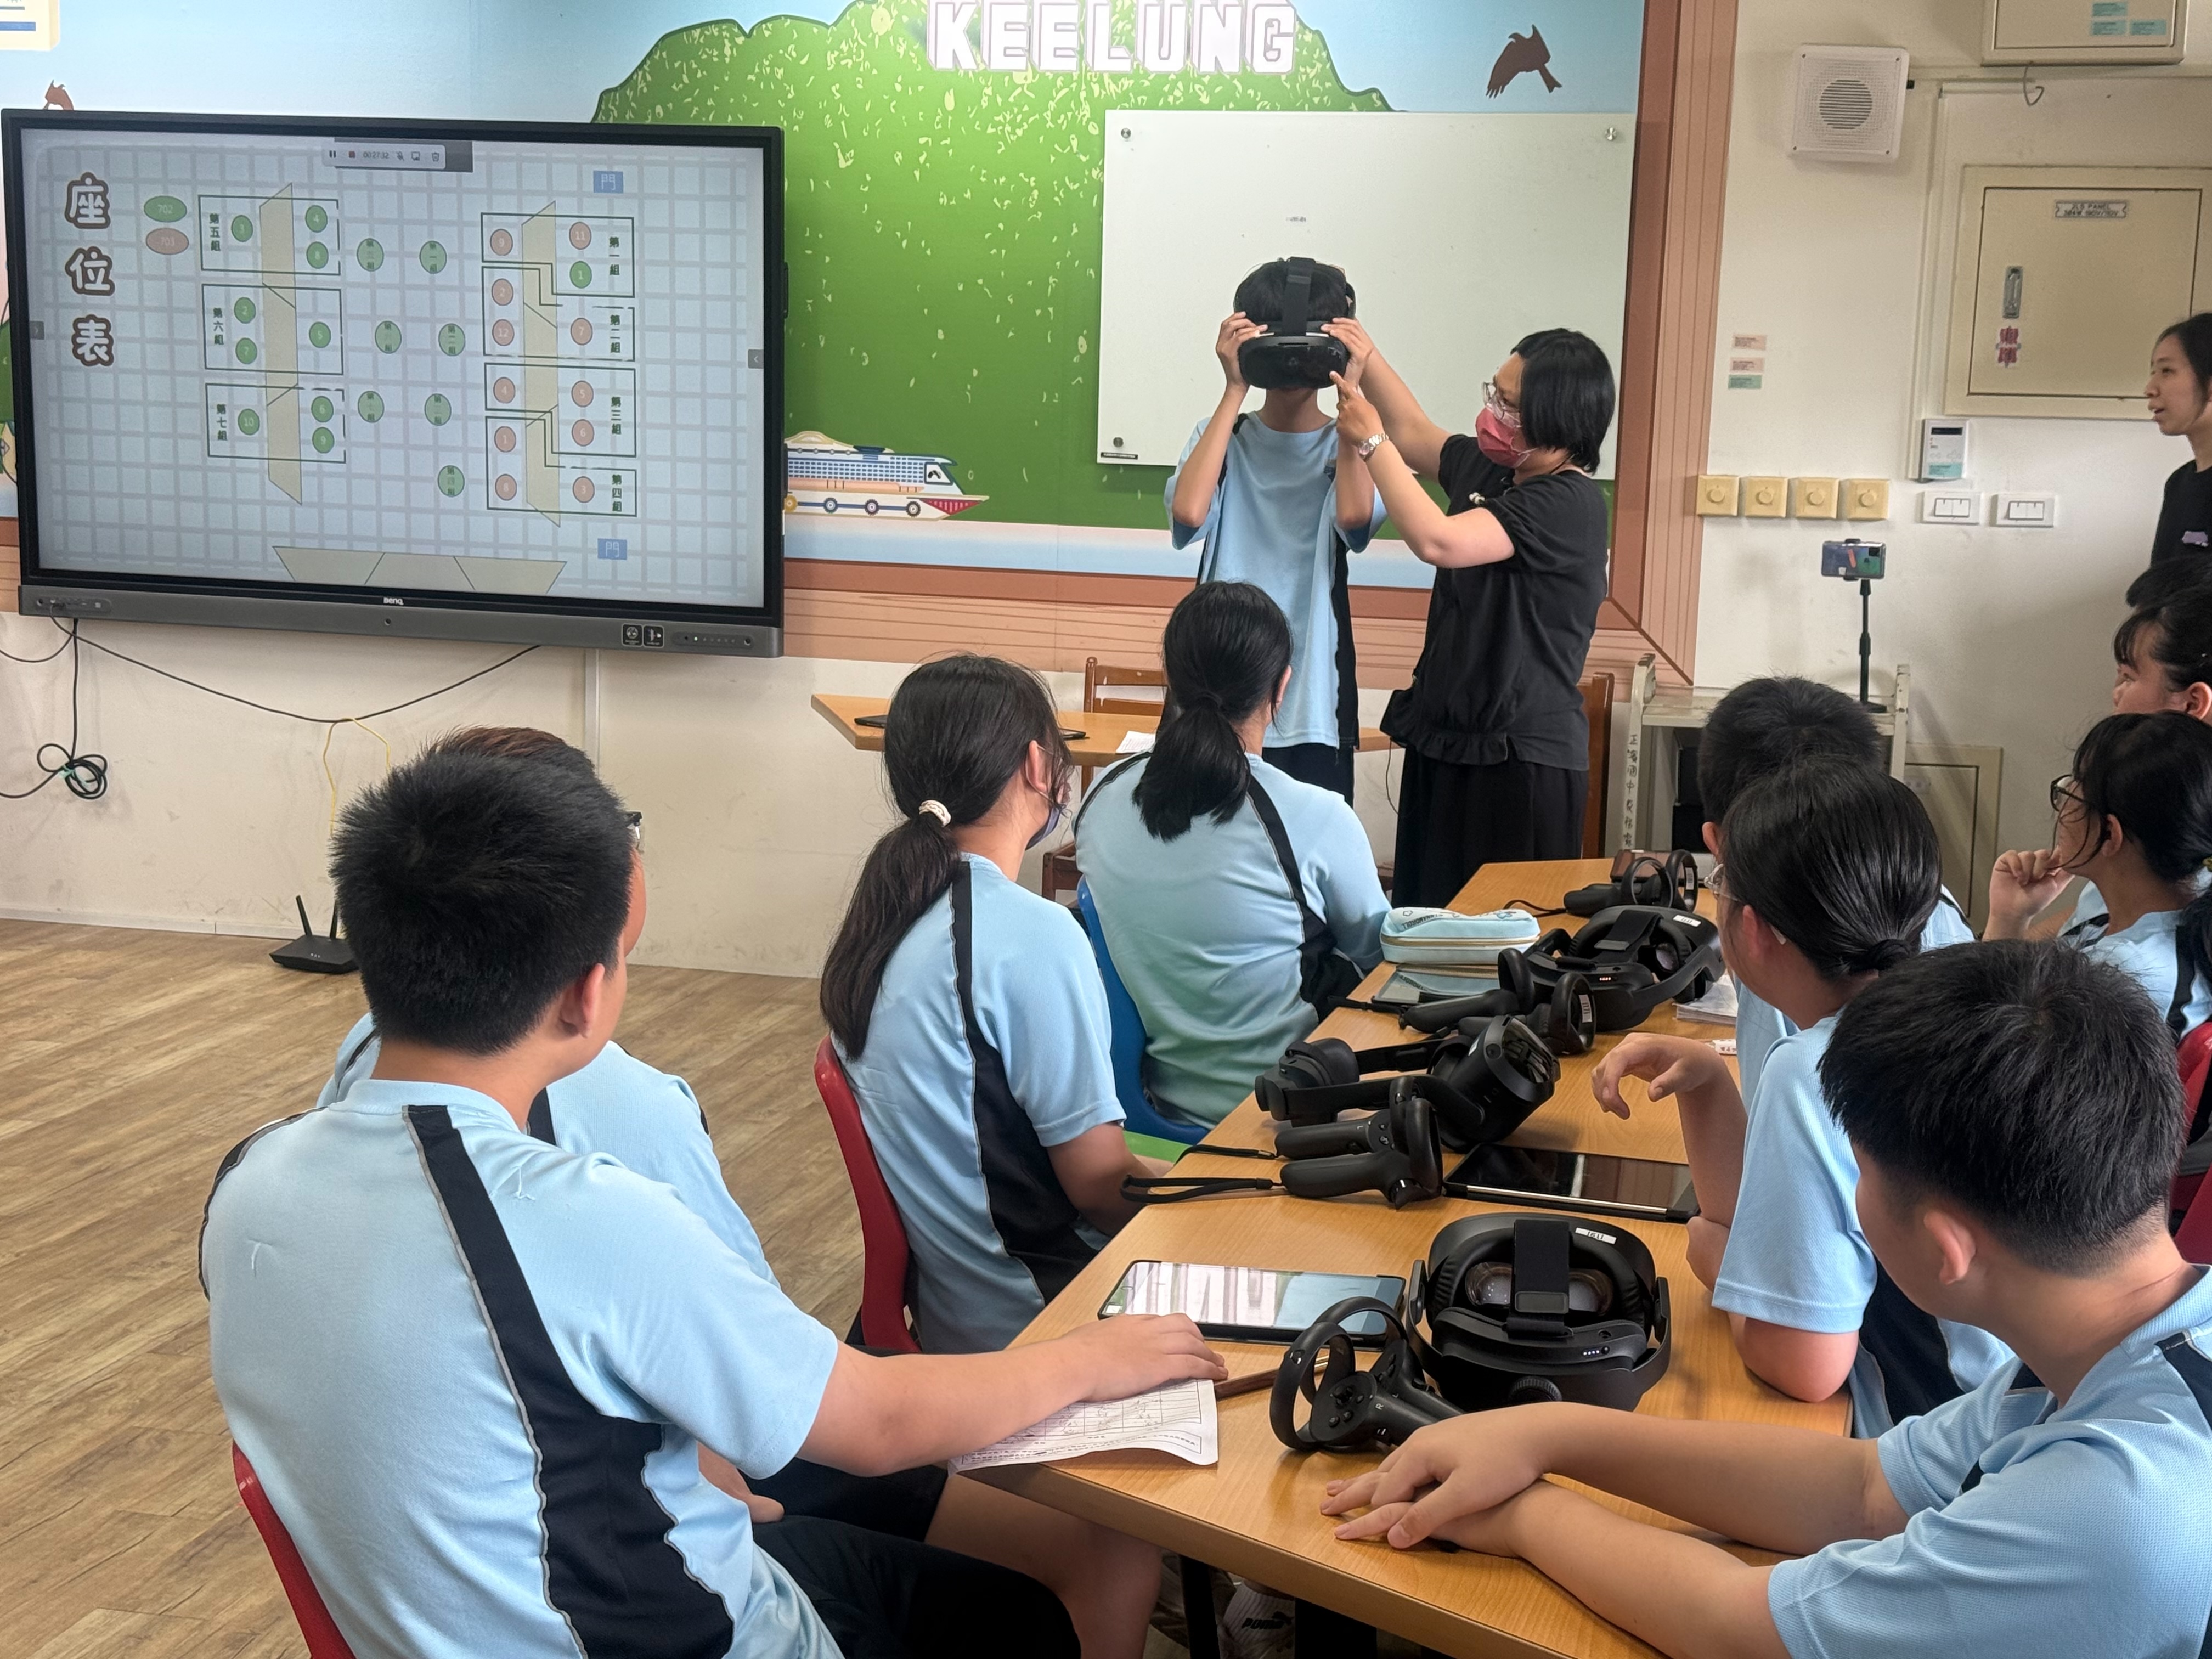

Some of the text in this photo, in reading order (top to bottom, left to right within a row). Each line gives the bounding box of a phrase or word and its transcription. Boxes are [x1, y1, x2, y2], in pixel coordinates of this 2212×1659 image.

[928, 0, 1296, 72] KEELUNG
[601, 174, 616, 190] 門
[157, 204, 173, 214] 702
[210, 213, 221, 251] 第五組
[575, 232, 586, 240] 11
[65, 172, 115, 366] 座位表
[609, 236, 619, 275] 第一組
[213, 308, 224, 345] 第六組
[498, 329, 509, 337] 12
[610, 315, 620, 353] 第二組
[217, 404, 227, 441] 第七組
[244, 417, 254, 426] 10
[611, 397, 622, 435] 第三組
[612, 475, 622, 512] 第四組
[605, 541, 619, 557] 門
